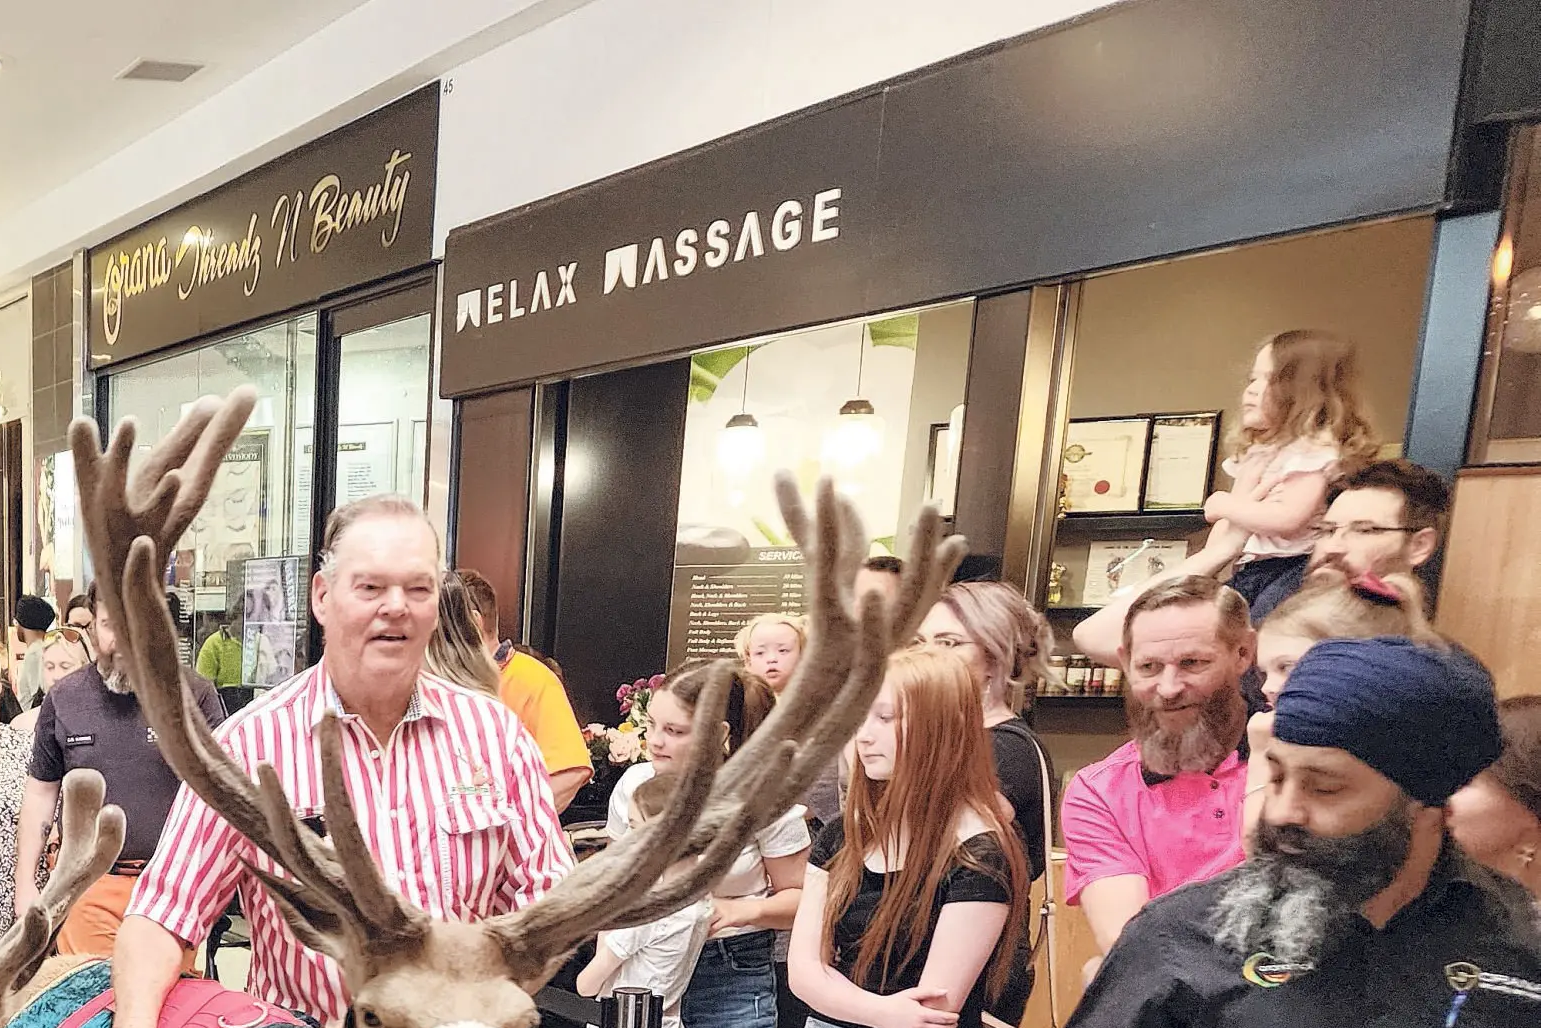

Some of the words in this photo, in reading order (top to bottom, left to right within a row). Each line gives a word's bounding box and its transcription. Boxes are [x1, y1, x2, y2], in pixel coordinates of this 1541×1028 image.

[443, 78, 455, 96] 45
[309, 149, 412, 254] Beauty
[455, 262, 578, 333] RELAX
[603, 187, 842, 295] MASSAGE
[758, 550, 804, 561] SERVIC
